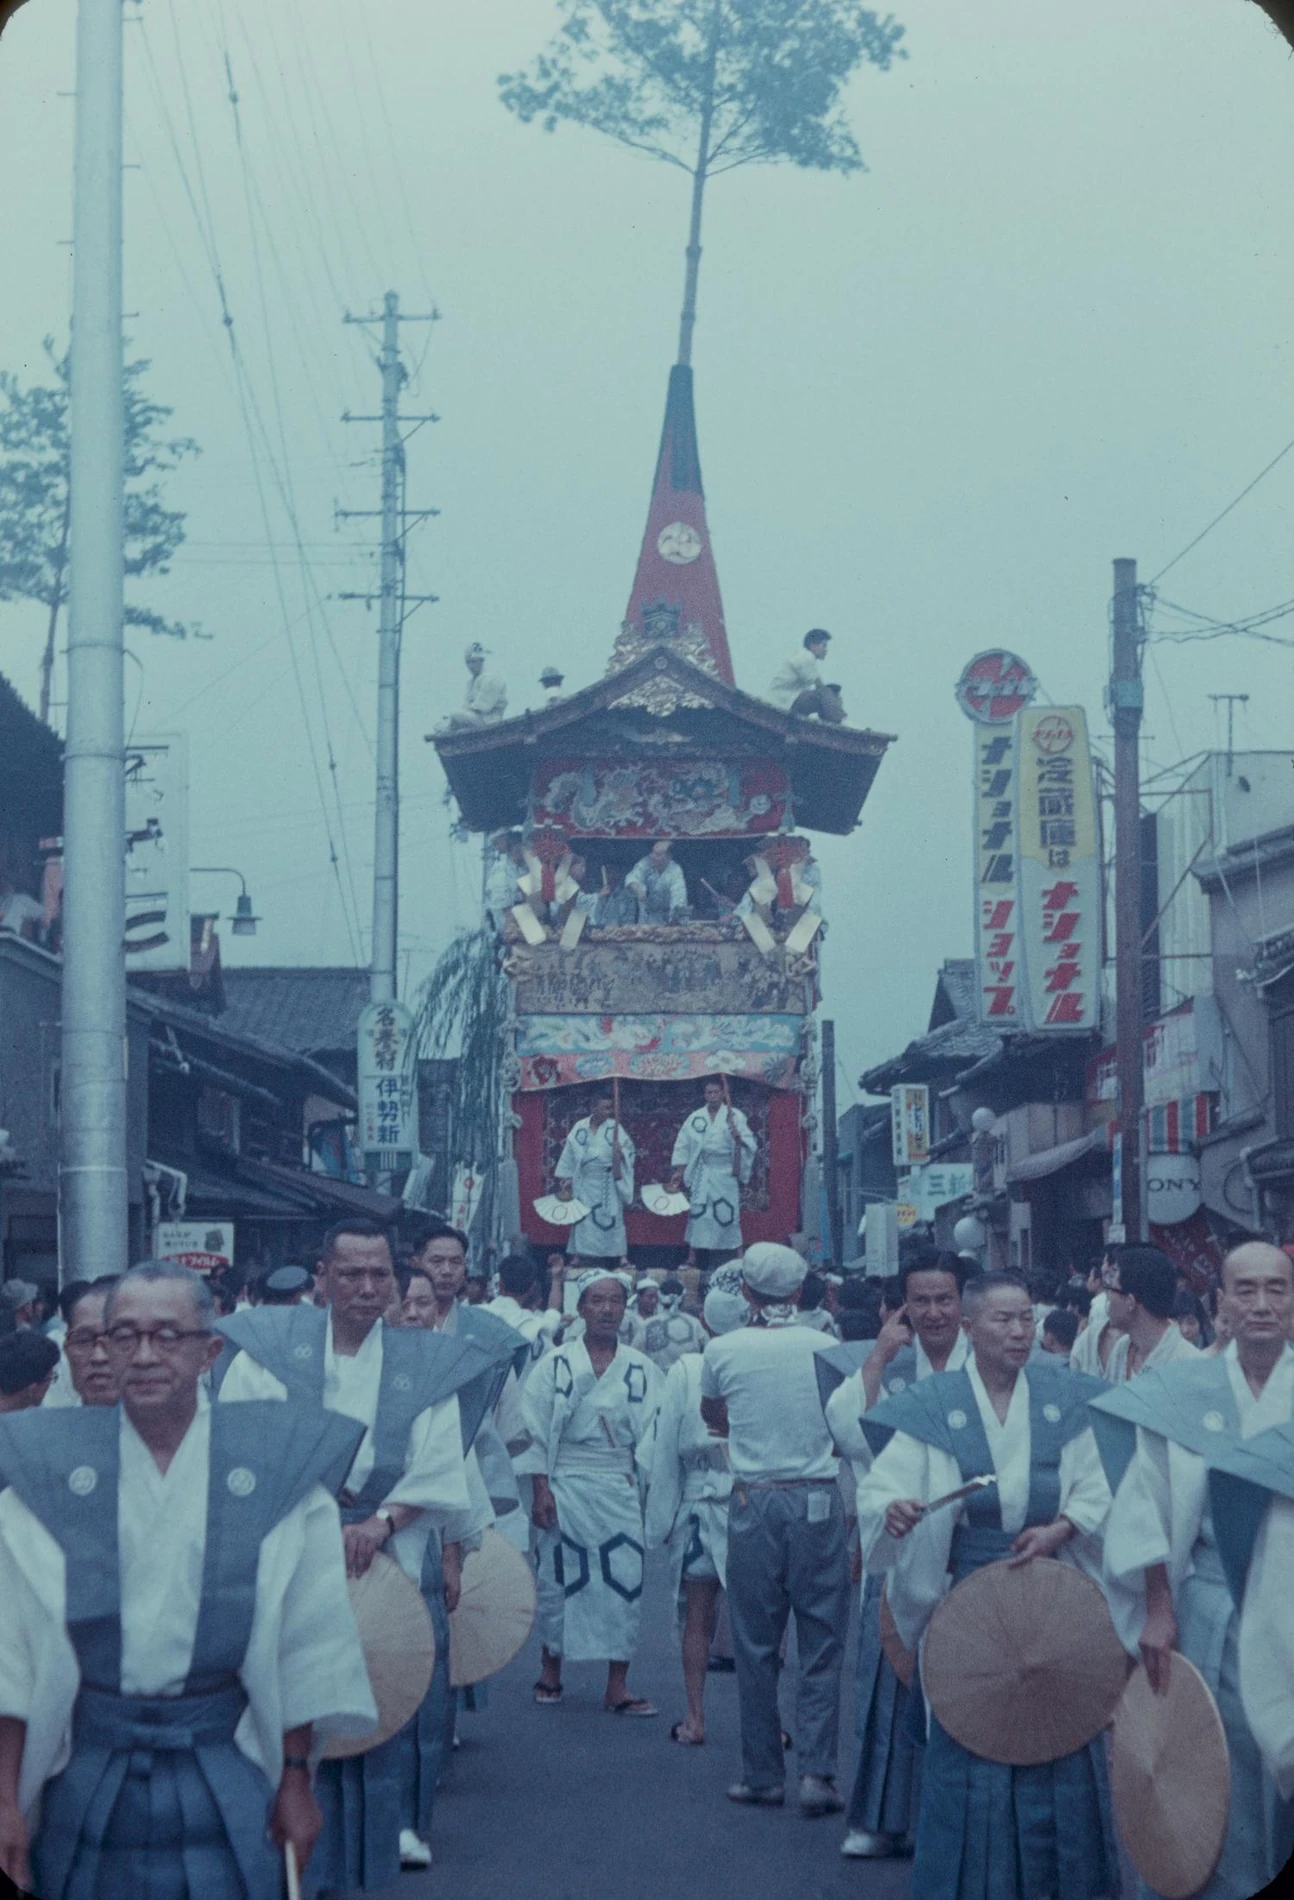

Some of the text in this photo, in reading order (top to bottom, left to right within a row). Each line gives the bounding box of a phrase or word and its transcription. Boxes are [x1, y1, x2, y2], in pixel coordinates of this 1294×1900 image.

[981, 736, 1016, 1017] ナショナル ショップ
[1037, 756, 1085, 1024] 冷蔵庫は ナショナル
[1148, 1178, 1200, 1193] ONY
